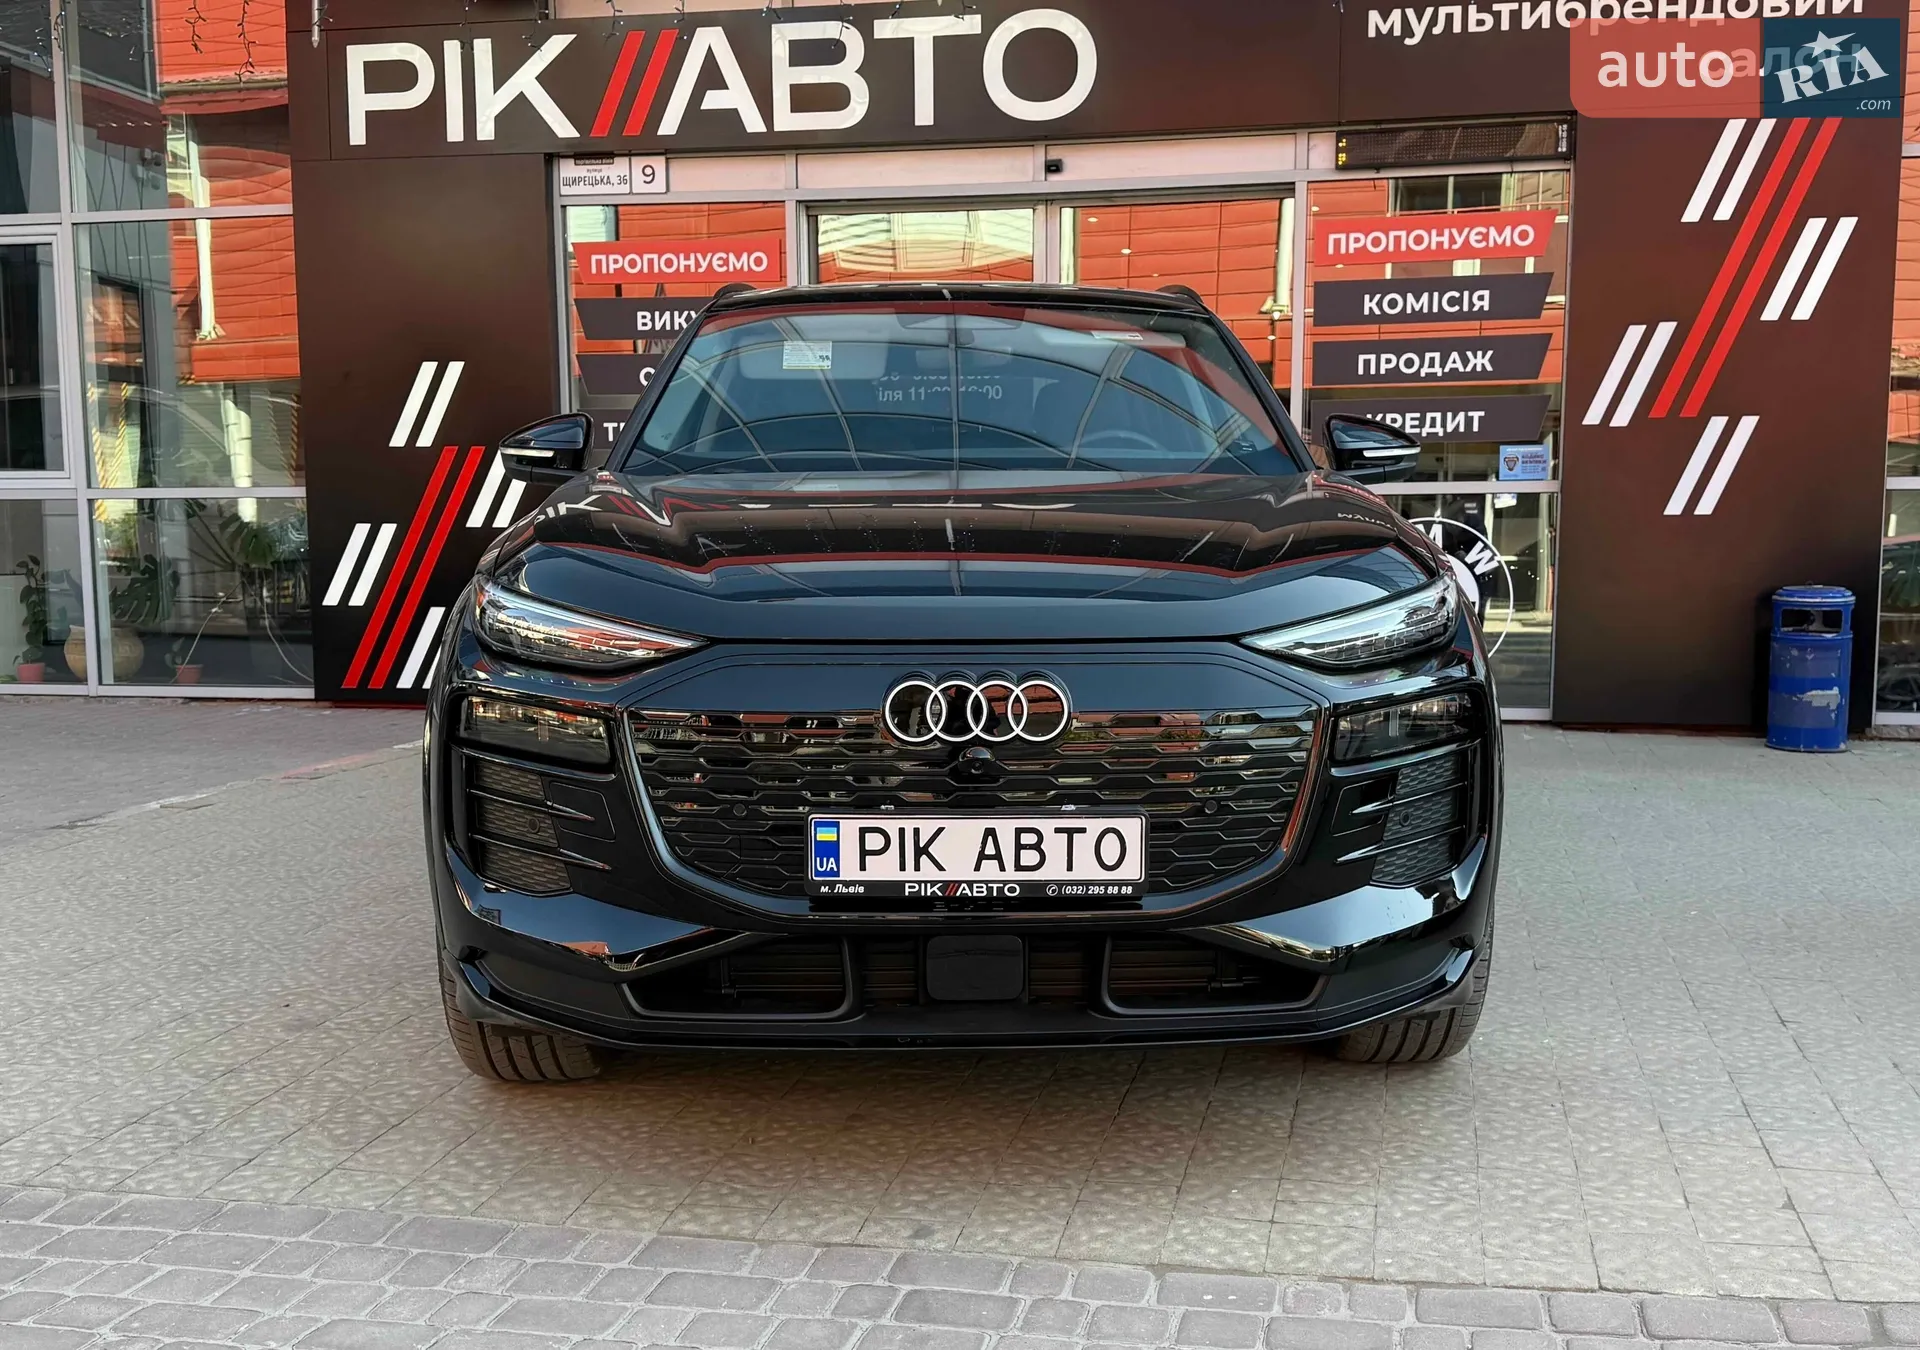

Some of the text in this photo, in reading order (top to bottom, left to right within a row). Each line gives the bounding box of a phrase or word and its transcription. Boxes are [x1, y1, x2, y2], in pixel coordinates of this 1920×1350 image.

[346, 8, 1099, 146] РІК АВТО
[562, 174, 628, 188] ЩИРЕЦЬКА, 36
[641, 164, 656, 185] 9
[1327, 223, 1536, 255] ПРОПОНУЄМО
[590, 251, 768, 274] ПРОПОНУЄМО
[1362, 289, 1491, 315] КОМІСІЯ
[1357, 350, 1494, 378] ПРОДАЖ
[858, 826, 1128, 873] РІК АВТО
[816, 857, 838, 872] UA
[833, 883, 865, 894] Львів
[904, 882, 1021, 897] РІК АВТО
[1061, 885, 1133, 895] (032) 295 88 88
